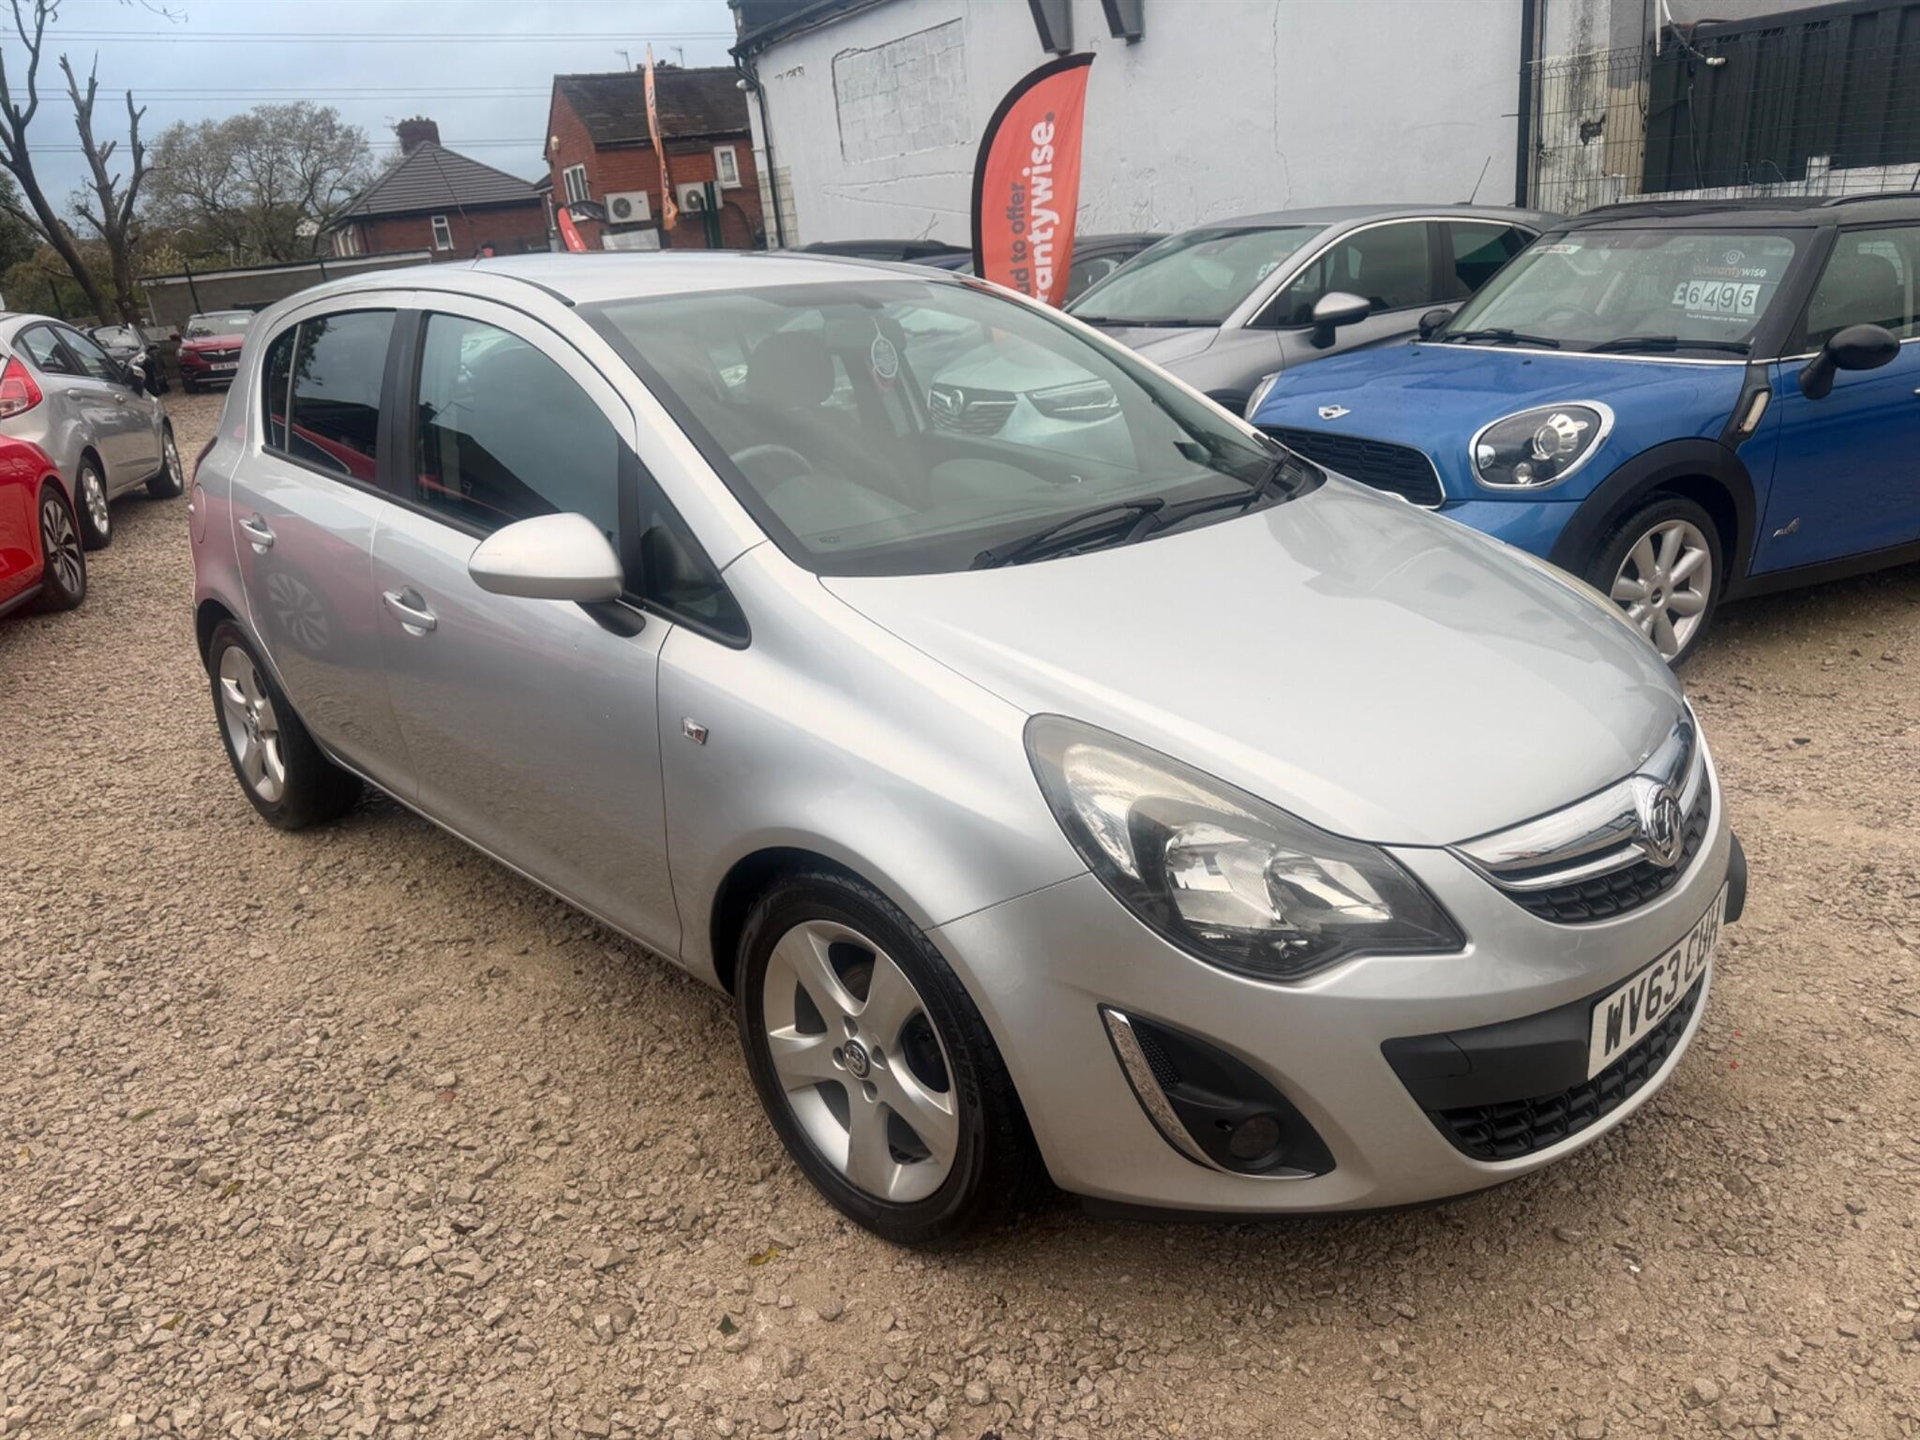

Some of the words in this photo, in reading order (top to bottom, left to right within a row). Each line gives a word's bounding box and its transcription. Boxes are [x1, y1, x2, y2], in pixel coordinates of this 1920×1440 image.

[1006, 182, 1026, 235] offer
[1010, 239, 1027, 264] to
[1672, 281, 1757, 309] £6495
[1604, 949, 1682, 1058] WV63
